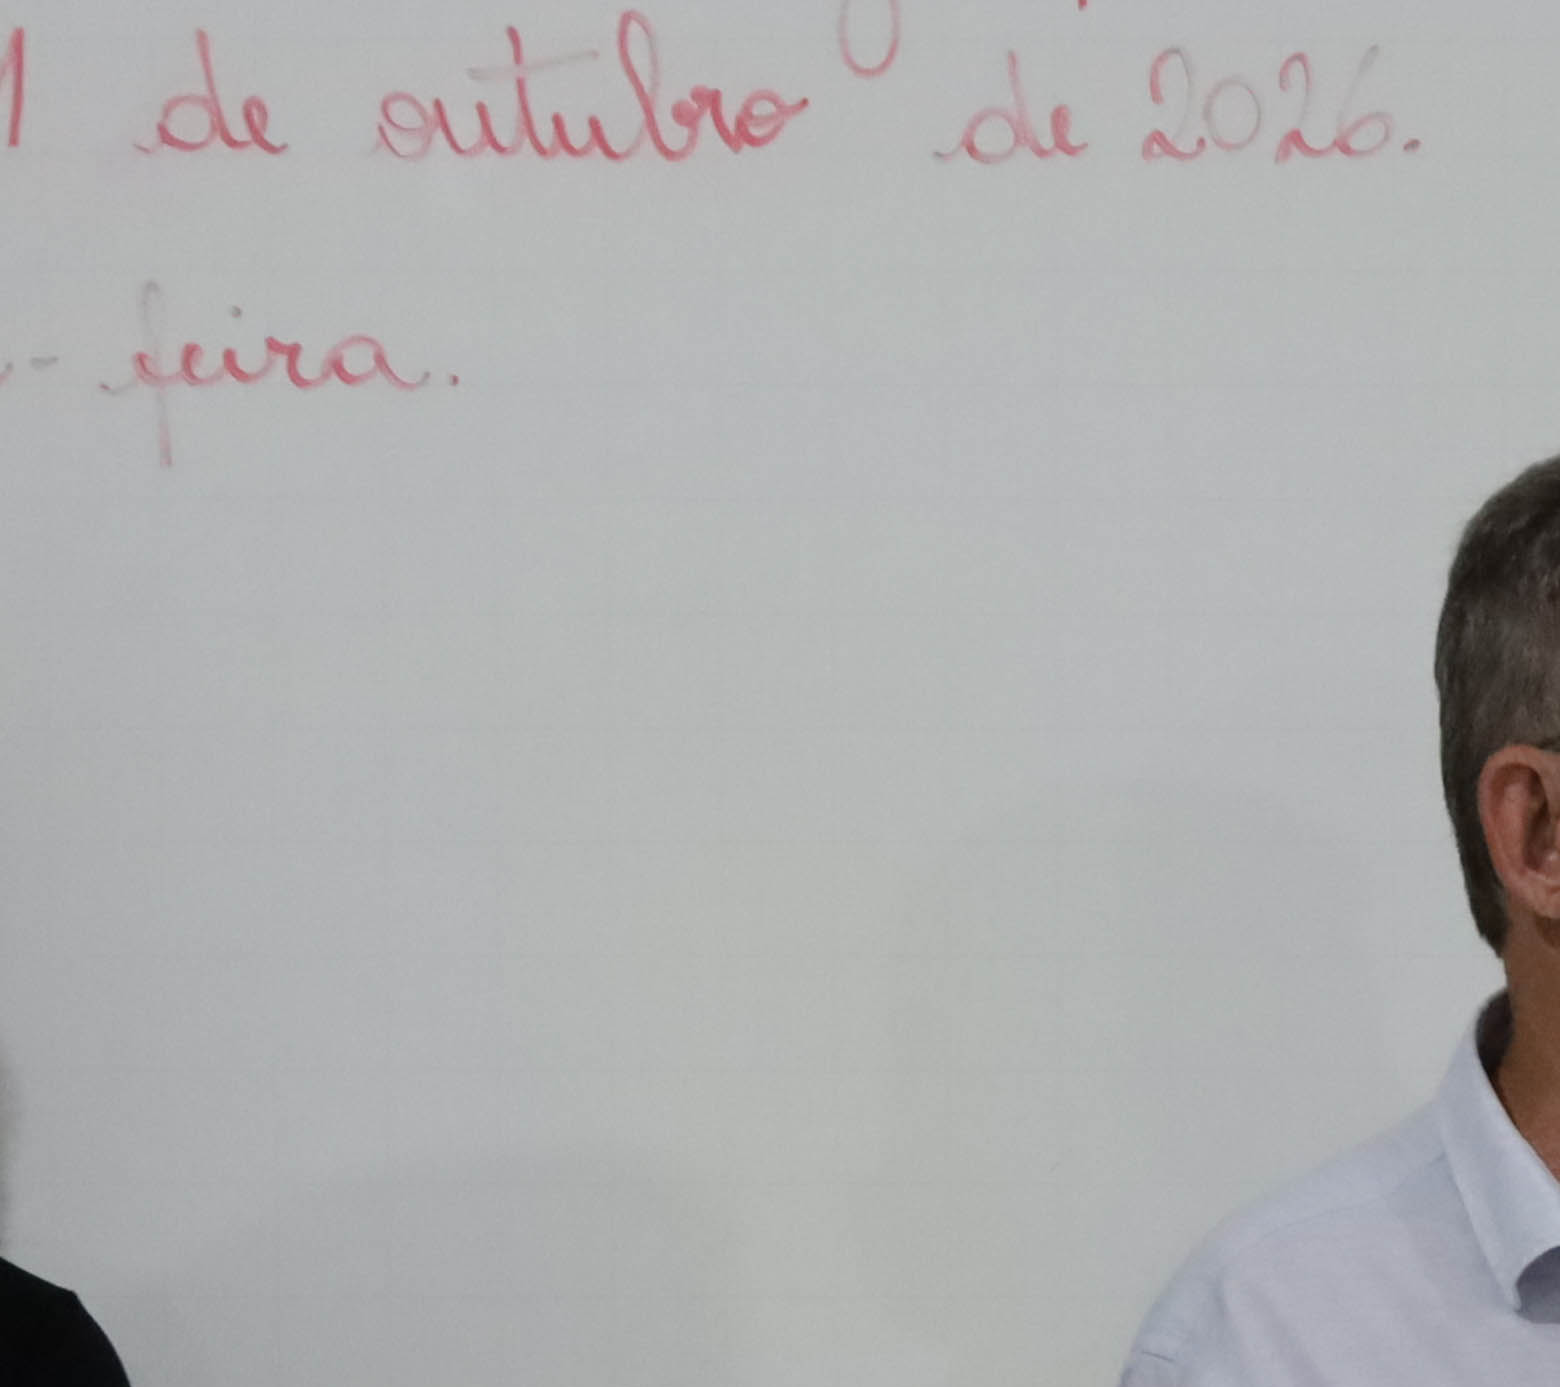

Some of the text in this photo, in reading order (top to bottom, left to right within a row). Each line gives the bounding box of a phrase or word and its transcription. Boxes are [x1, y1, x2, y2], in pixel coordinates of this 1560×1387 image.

[134, 27, 288, 157] de
[375, 8, 810, 163] outubro
[933, 50, 1089, 165] de
[1140, 45, 1422, 163] 2026.
